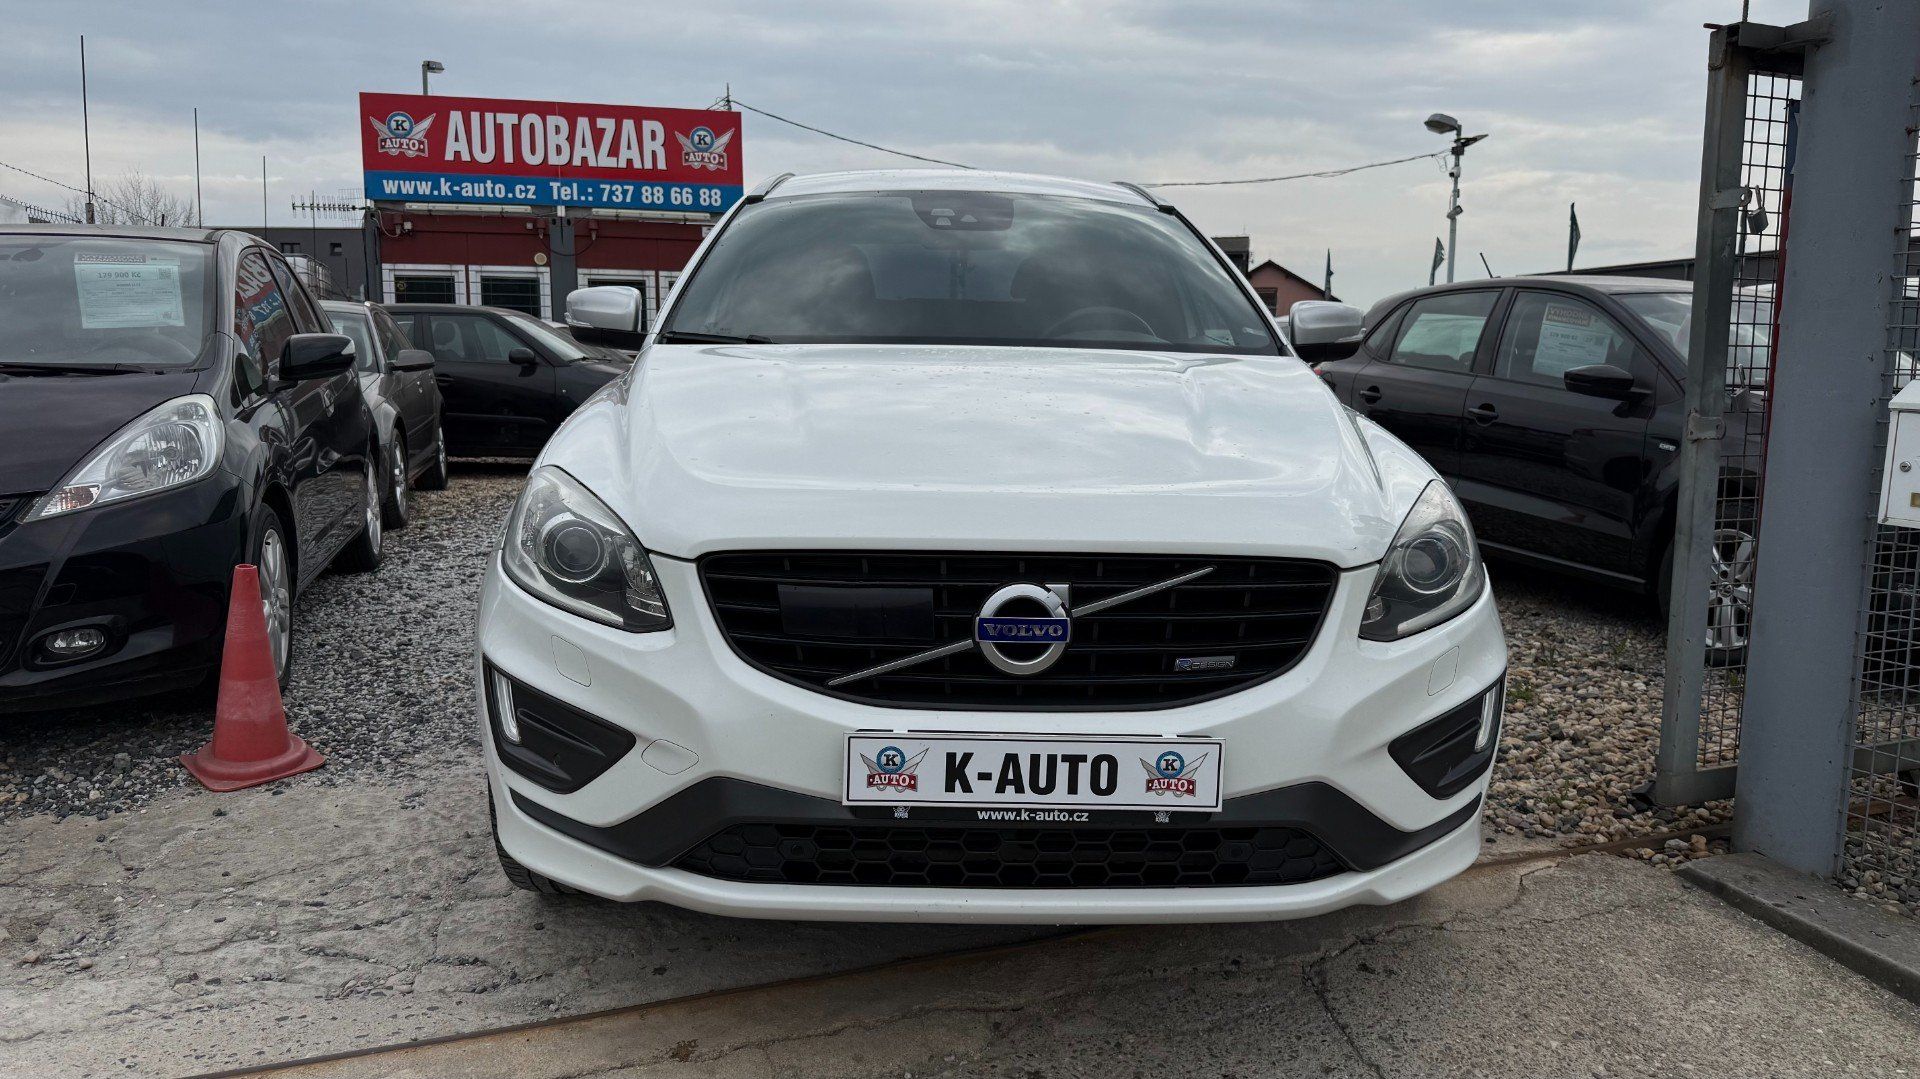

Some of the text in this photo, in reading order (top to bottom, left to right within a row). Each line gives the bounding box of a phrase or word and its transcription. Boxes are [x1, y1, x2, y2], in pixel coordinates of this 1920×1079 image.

[393, 119, 408, 131] K
[385, 138, 418, 151] AUTO
[445, 110, 667, 170] AUTOBAZAR
[696, 134, 709, 146] K
[688, 152, 719, 164] AUTO
[382, 177, 722, 207] www.k-auto.cz Tel.: 737 88 66 88
[983, 623, 1063, 637] VOLVO
[883, 753, 899, 767] K
[1162, 758, 1178, 772] K
[872, 773, 910, 787] AUTO
[944, 752, 1119, 797] K-AUTO
[1152, 779, 1188, 792] AUTO
[977, 808, 1089, 822] www.k-auto.cz
